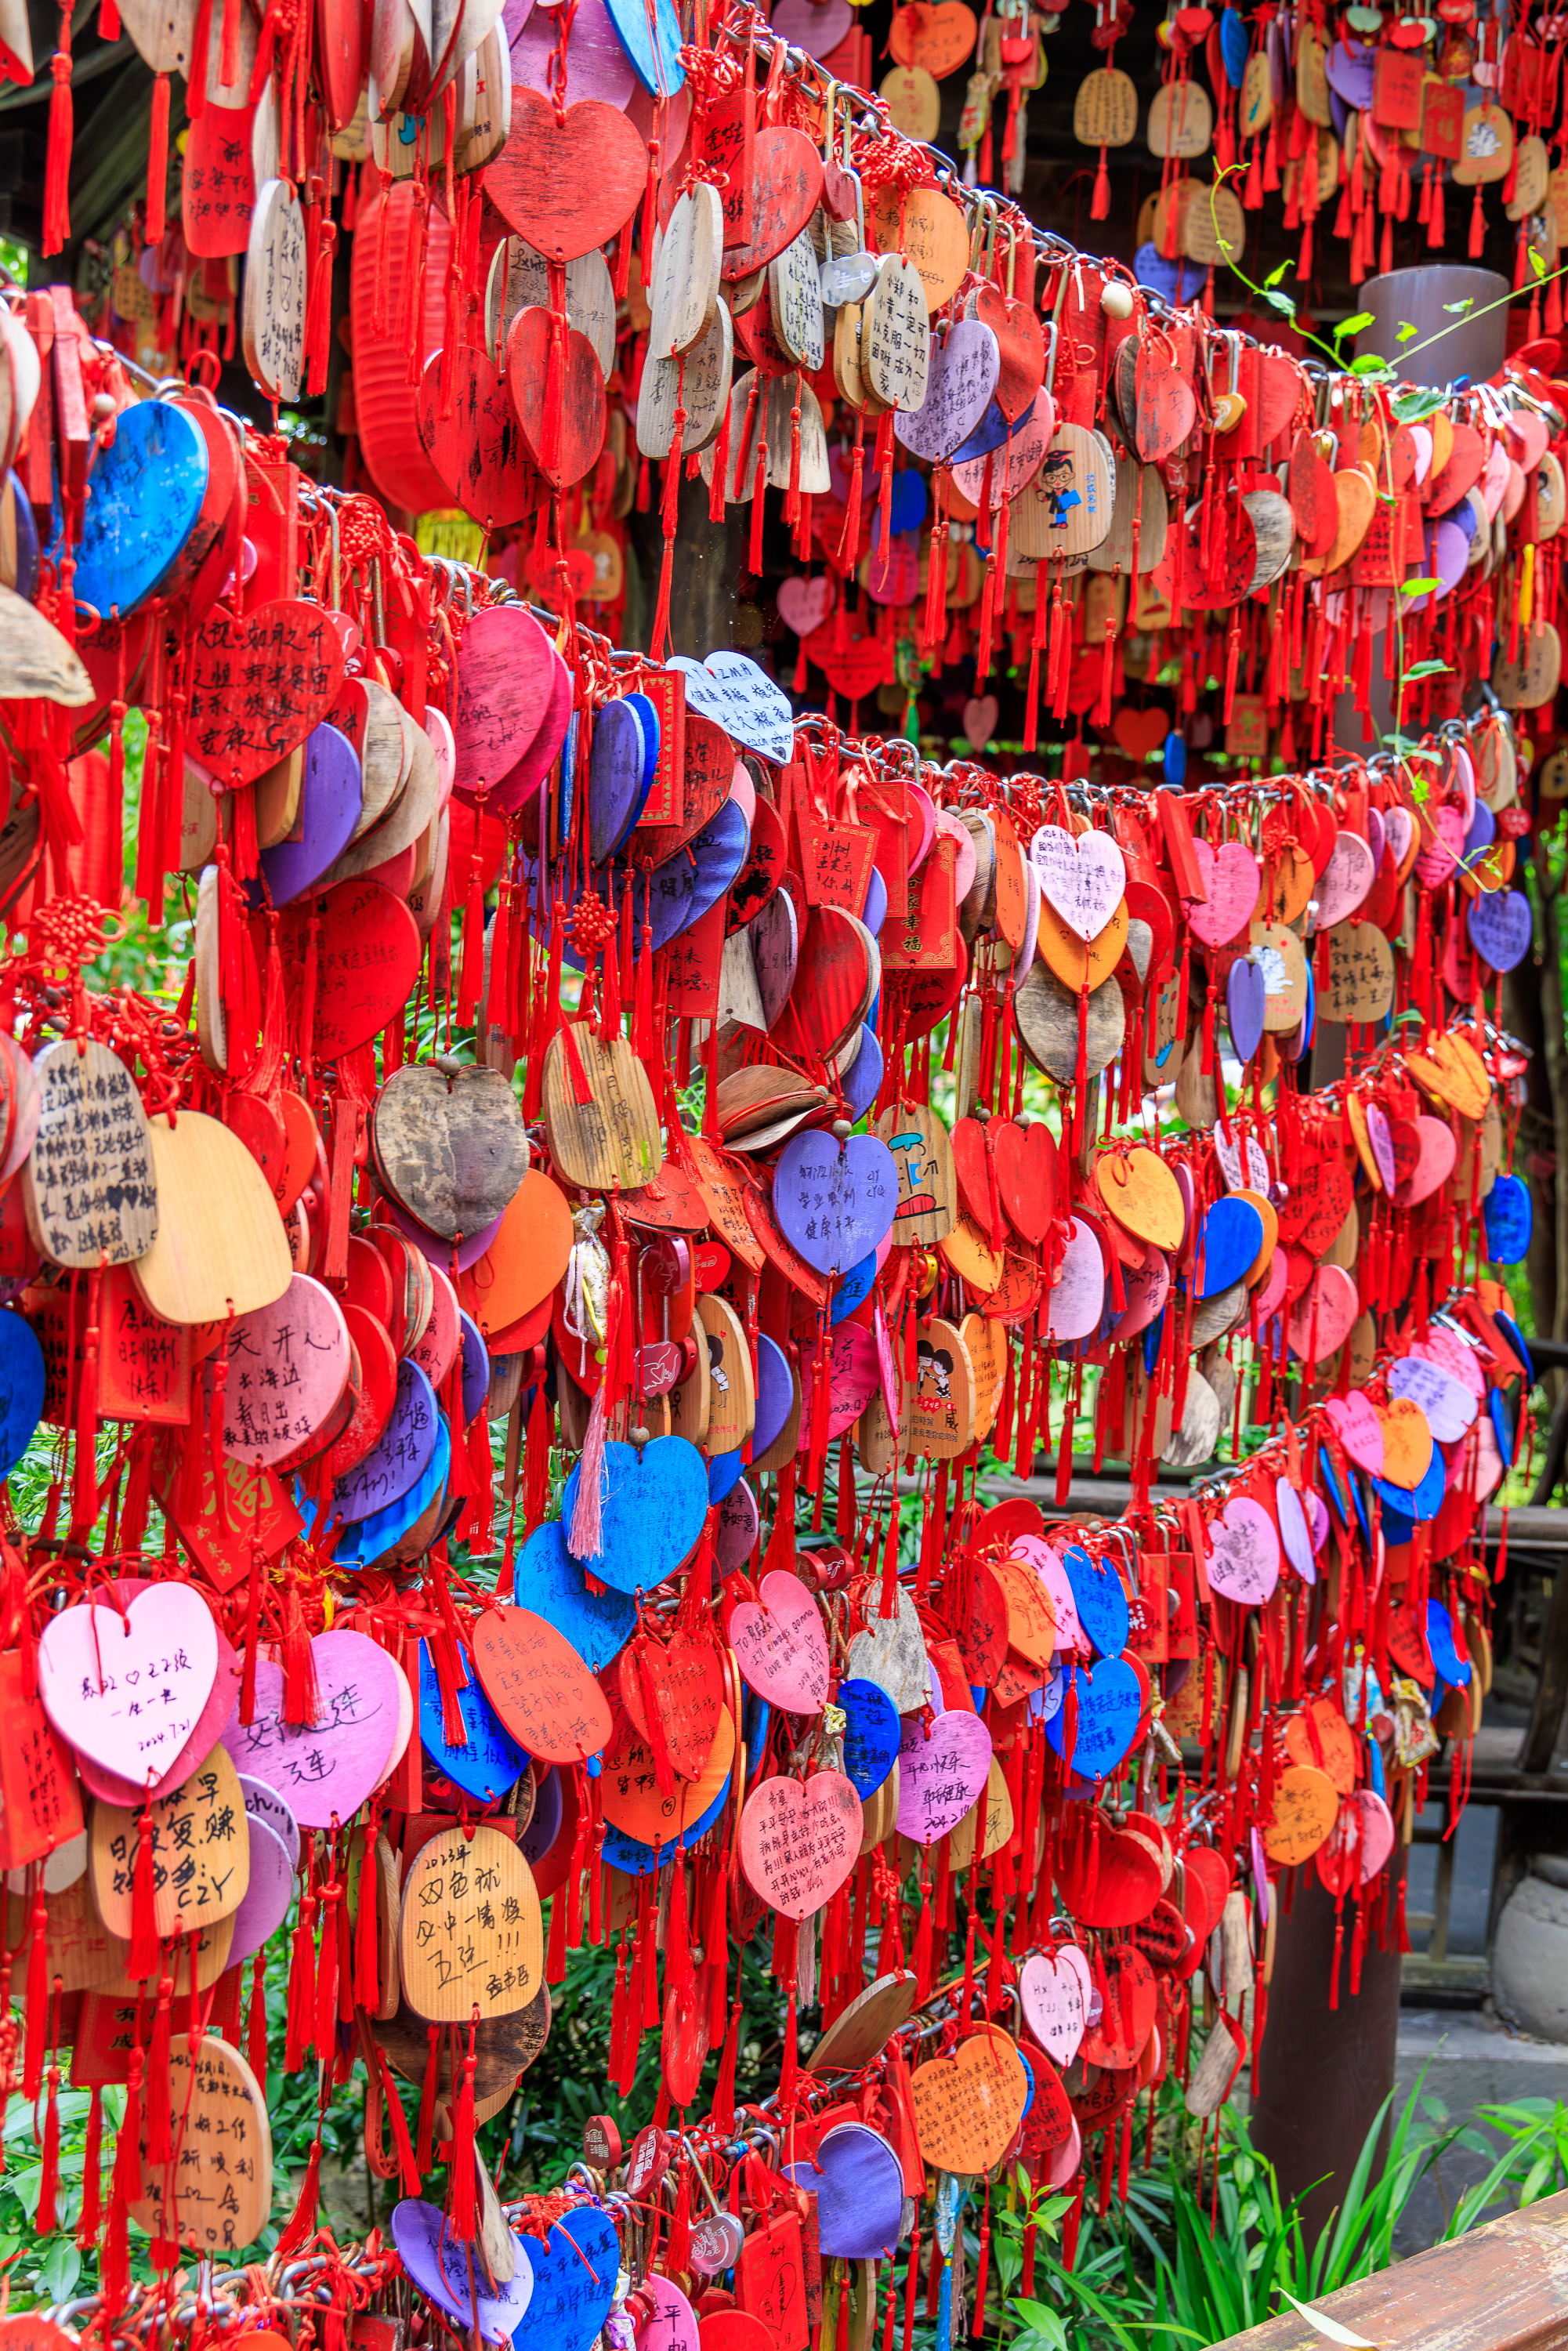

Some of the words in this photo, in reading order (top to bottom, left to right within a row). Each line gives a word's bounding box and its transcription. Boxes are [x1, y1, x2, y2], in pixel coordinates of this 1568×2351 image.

[900, 875, 923, 952] 合家幸福
[177, 1867, 234, 1909] CZY
[418, 1862, 502, 1907] 双色球
